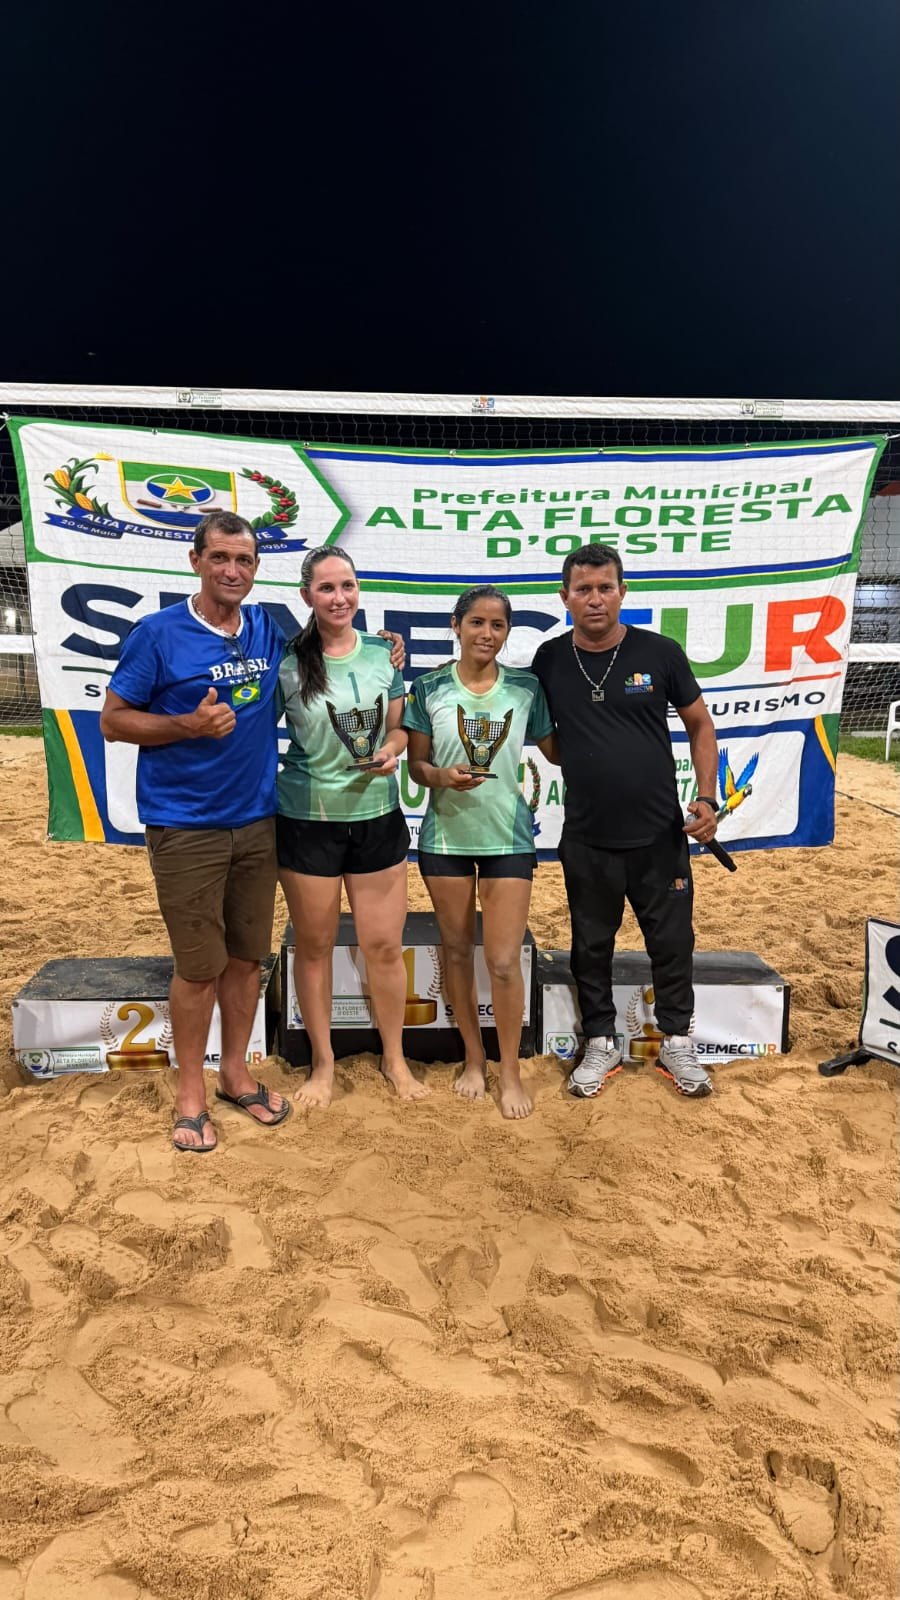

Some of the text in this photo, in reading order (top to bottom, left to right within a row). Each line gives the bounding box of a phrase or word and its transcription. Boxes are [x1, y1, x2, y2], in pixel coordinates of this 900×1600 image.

[413, 477, 812, 505] Prefeitura Municipal
[84, 512, 120, 530] ALTA
[365, 493, 853, 531] ALTA FLORESTA
[60, 518, 118, 538] 20 de Maio
[261, 542, 288, 552] 1986
[209, 657, 270, 682] BRASIL
[705, 691, 826, 716] URISMO
[117, 1002, 156, 1053] 2
[696, 1042, 777, 1057] SEMECTUR
